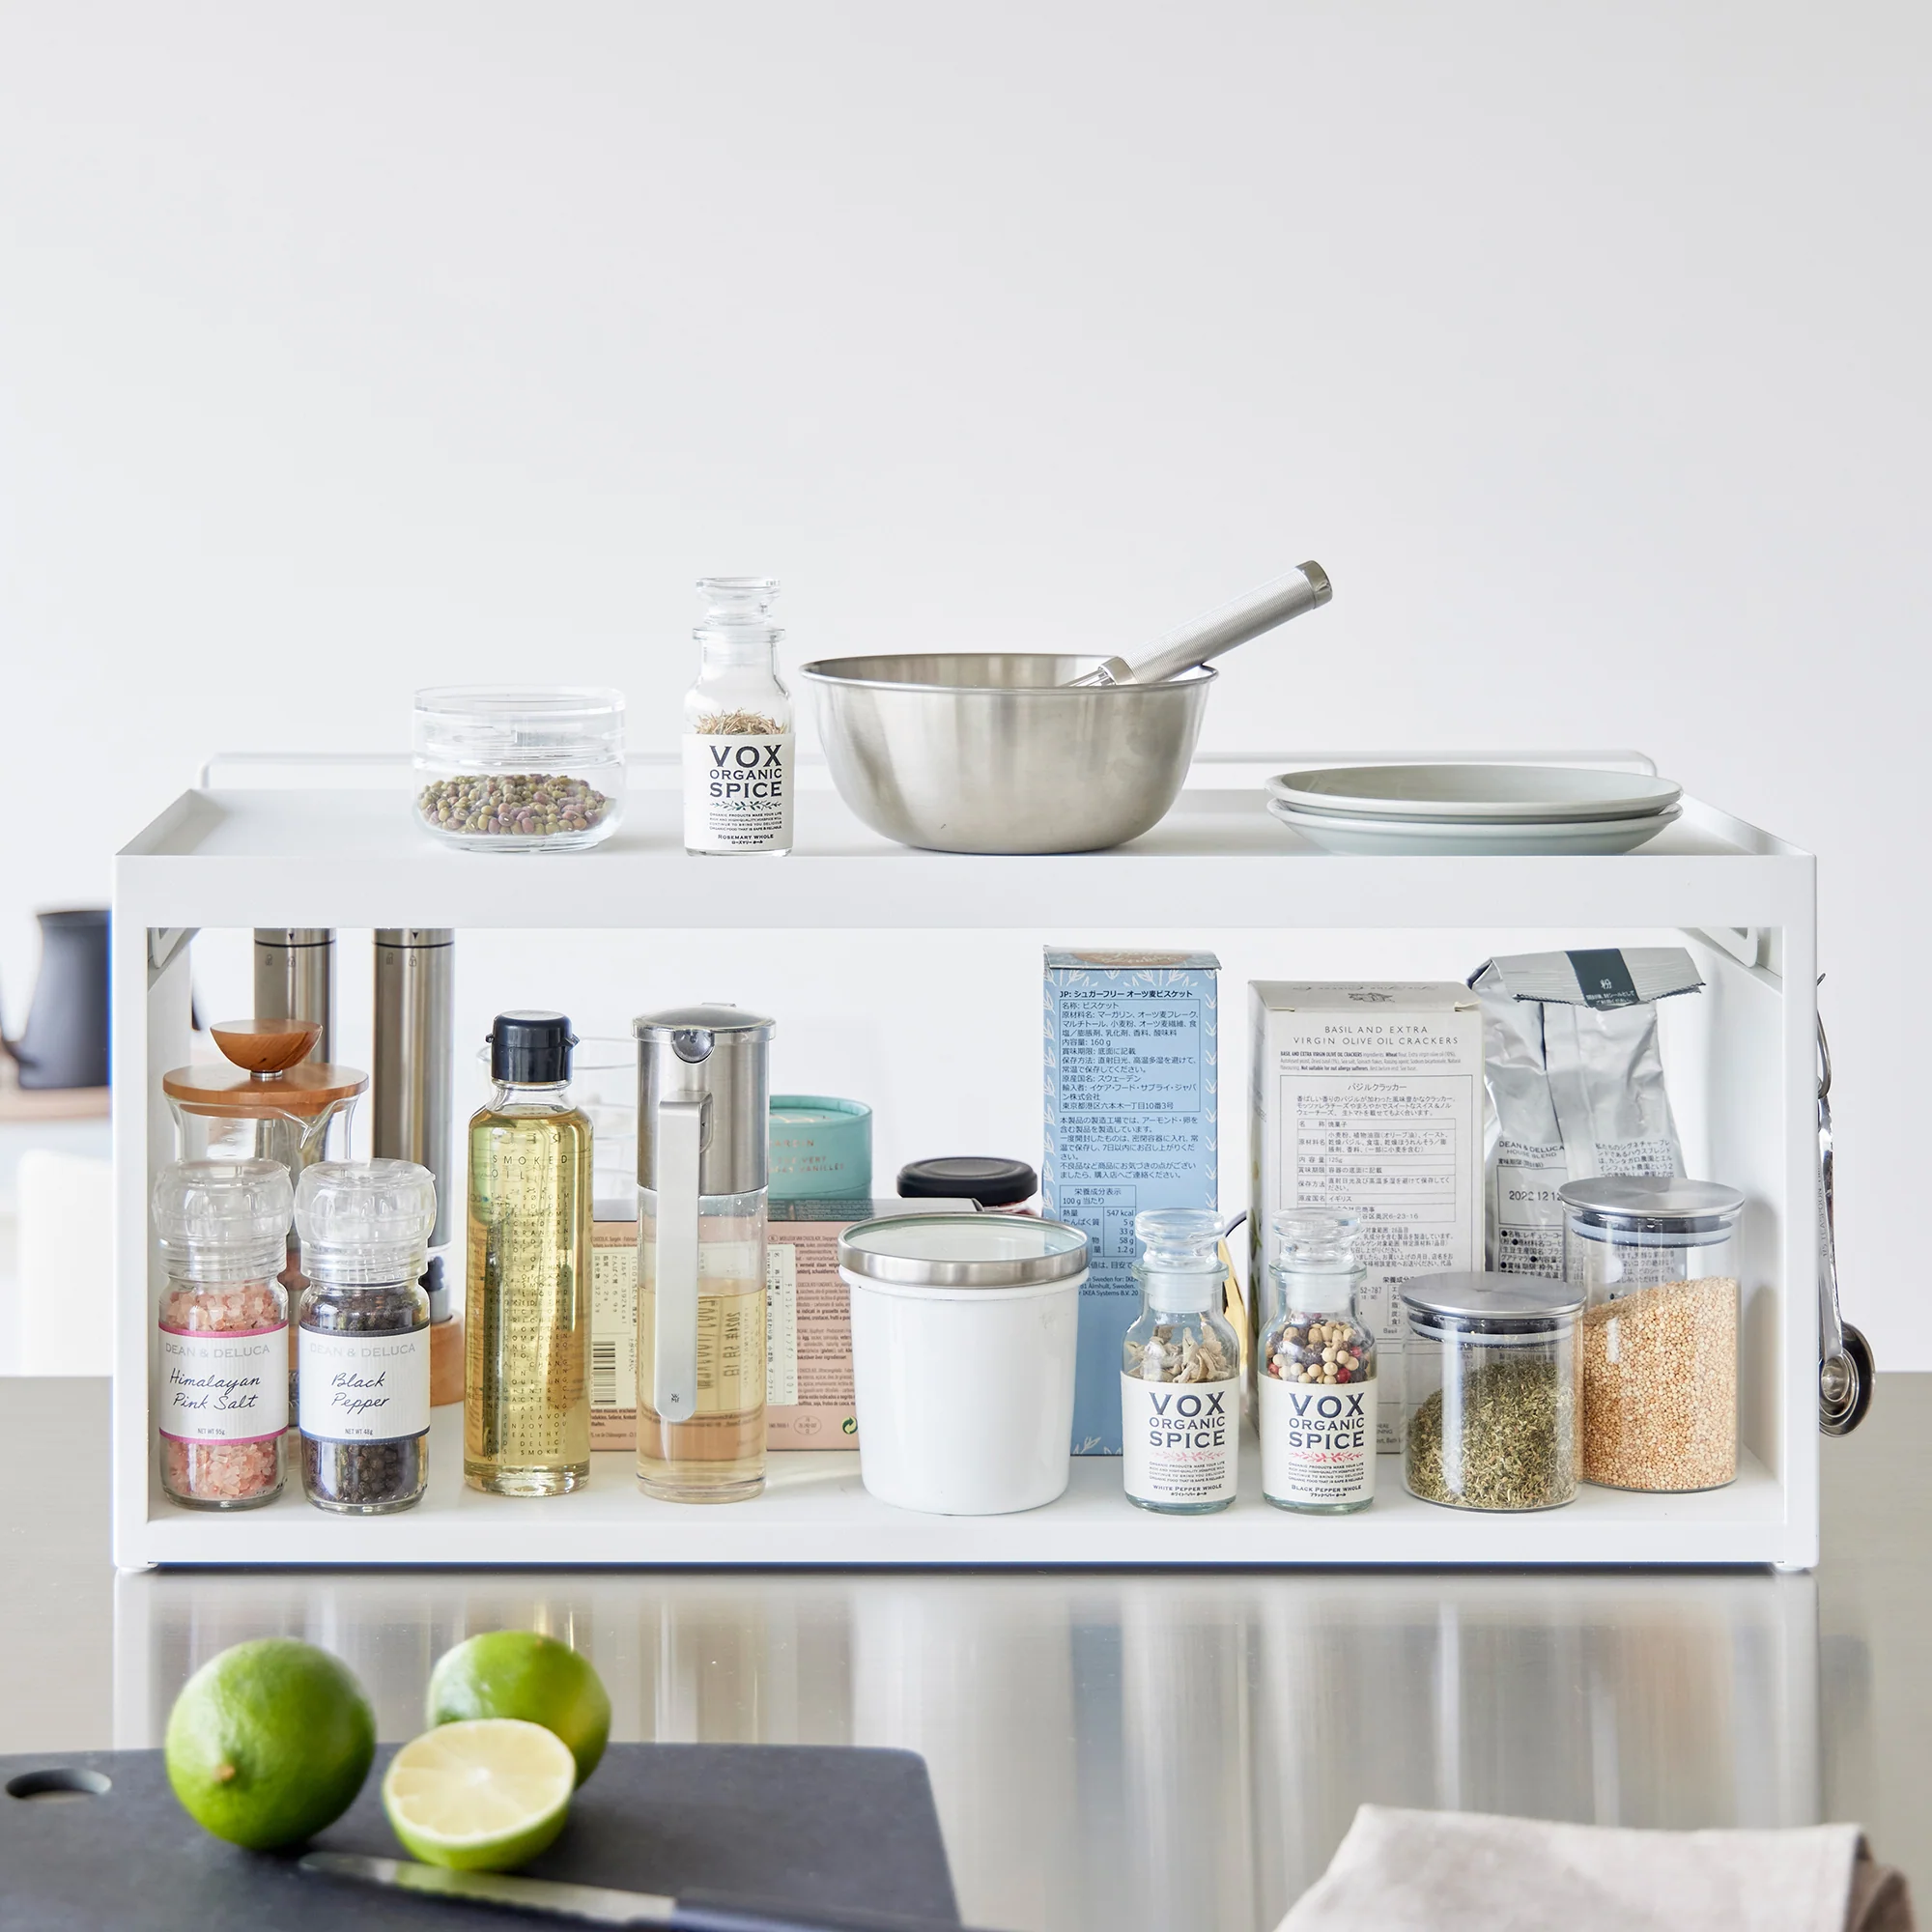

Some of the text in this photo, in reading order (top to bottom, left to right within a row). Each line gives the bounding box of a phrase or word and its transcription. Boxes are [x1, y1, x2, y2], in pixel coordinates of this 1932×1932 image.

[709, 744, 782, 768] VOX
[710, 768, 782, 780] ORGANIC
[710, 781, 782, 798] SPICE
[1600, 978, 1612, 990] 粉
[1293, 1037, 1335, 1045] VIRGIN
[1342, 1037, 1372, 1045] OLIVE
[1377, 1037, 1394, 1045] OIL
[1347, 1083, 1407, 1091] バジルクラッカー
[769, 1139, 814, 1147] ARDIN
[1499, 1140, 1522, 1149] DEAN
[493, 1154, 568, 1166] SMOKED
[491, 1169, 525, 1180] OIL
[165, 1342, 271, 1359] DEAN & DELUCA
[310, 1342, 416, 1358] DEAN & DELUCA
[169, 1368, 261, 1395] Himalayan
[331, 1370, 386, 1388] Black
[172, 1392, 259, 1411] Pink Salt
[331, 1392, 390, 1415] Pepper
[1148, 1391, 1225, 1417] VOX
[1288, 1392, 1364, 1419] VOX
[1149, 1416, 1225, 1430] ORGANIC
[1289, 1417, 1364, 1431] ORGANIC
[1149, 1429, 1225, 1449] SPICE
[1289, 1430, 1364, 1449] SPICE
